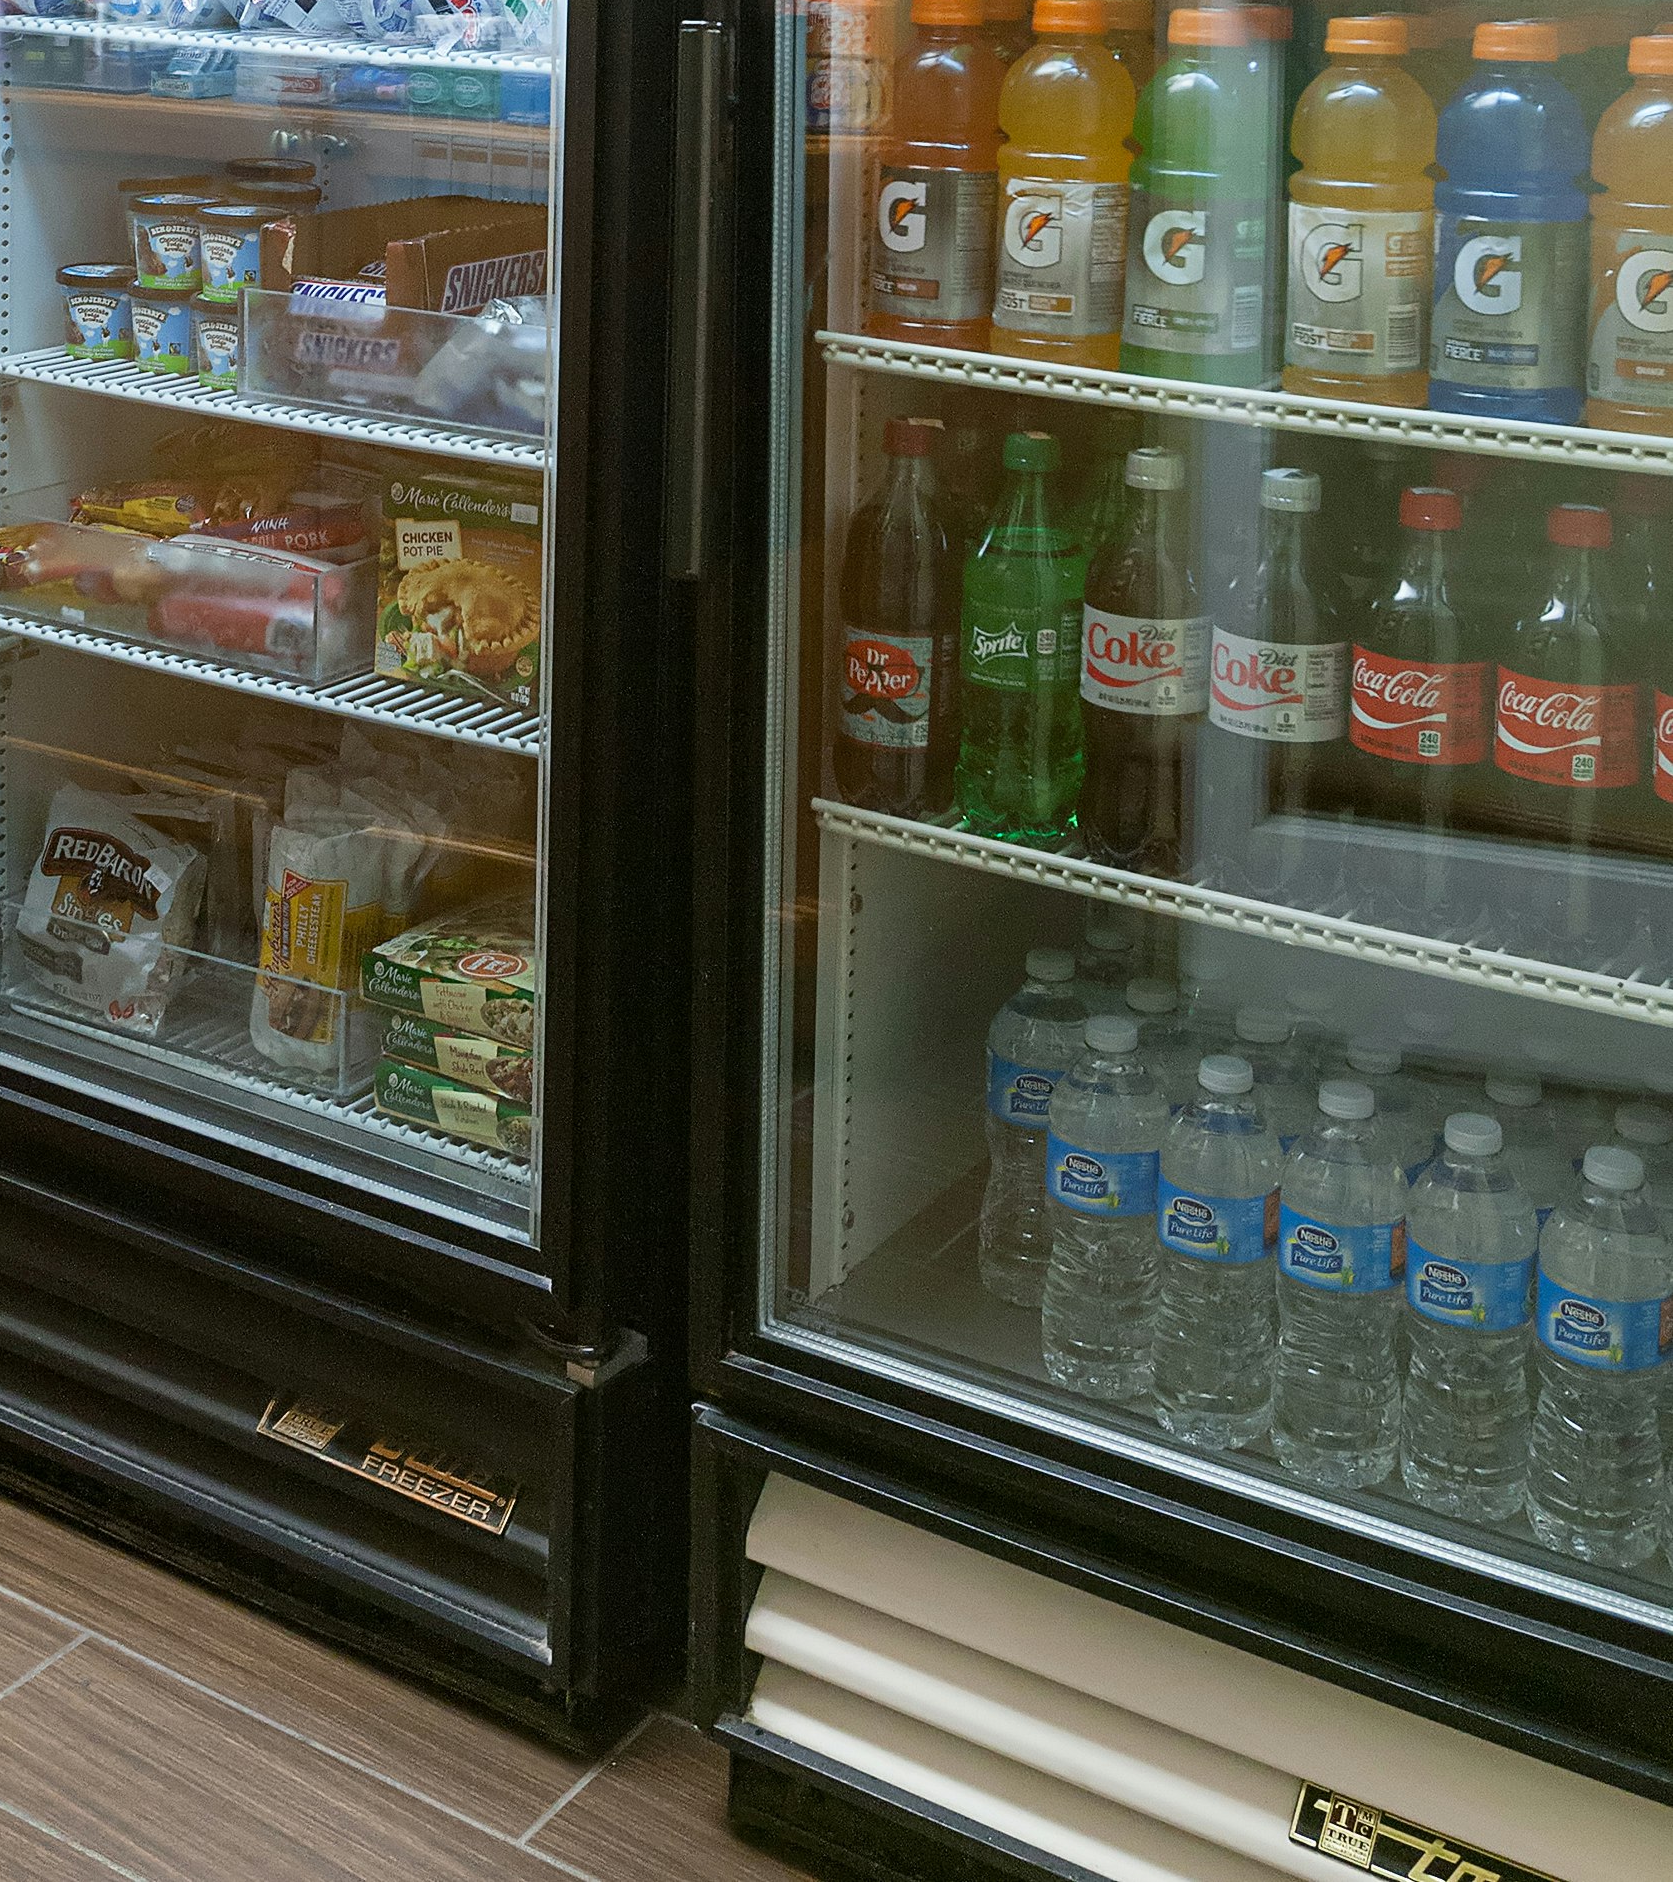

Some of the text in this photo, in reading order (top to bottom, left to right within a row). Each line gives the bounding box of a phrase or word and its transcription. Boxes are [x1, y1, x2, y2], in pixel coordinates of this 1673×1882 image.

[878, 180, 927, 253] G
[1005, 187, 1063, 269] G
[1143, 209, 1207, 286] G
[1301, 223, 1364, 304] G
[443, 249, 547, 313] SNICKERS
[1454, 235, 1523, 316] G
[1444, 343, 1483, 363] FIERCE
[399, 486, 442, 510] Marie
[285, 529, 330, 549] PORK
[402, 530, 454, 545] CHICKEN
[403, 544, 444, 558] POT PIE
[973, 628, 1023, 659] Sprite
[1137, 623, 1178, 643] Diet
[1086, 621, 1178, 669] Coke
[866, 647, 890, 667] Dr
[1212, 641, 1296, 696] Coke
[1258, 647, 1298, 668] Diet
[848, 656, 912, 695] Pepper
[1353, 656, 1449, 709] Coca-Cola
[1497, 680, 1603, 732] Coca-Cola
[1419, 731, 1440, 746] 240
[1573, 755, 1596, 771] 240
[382, 966, 413, 985] Marie
[1062, 1177, 1104, 1195] Pure Life
[1169, 1221, 1214, 1238] Pure Life
[1293, 1249, 1339, 1269] Pure Life
[1421, 1285, 1469, 1307] Pure Life
[1556, 1324, 1606, 1346] Pure Life
[360, 1454, 491, 1522] FREEZER
[1325, 1826, 1371, 1853] TRUE
